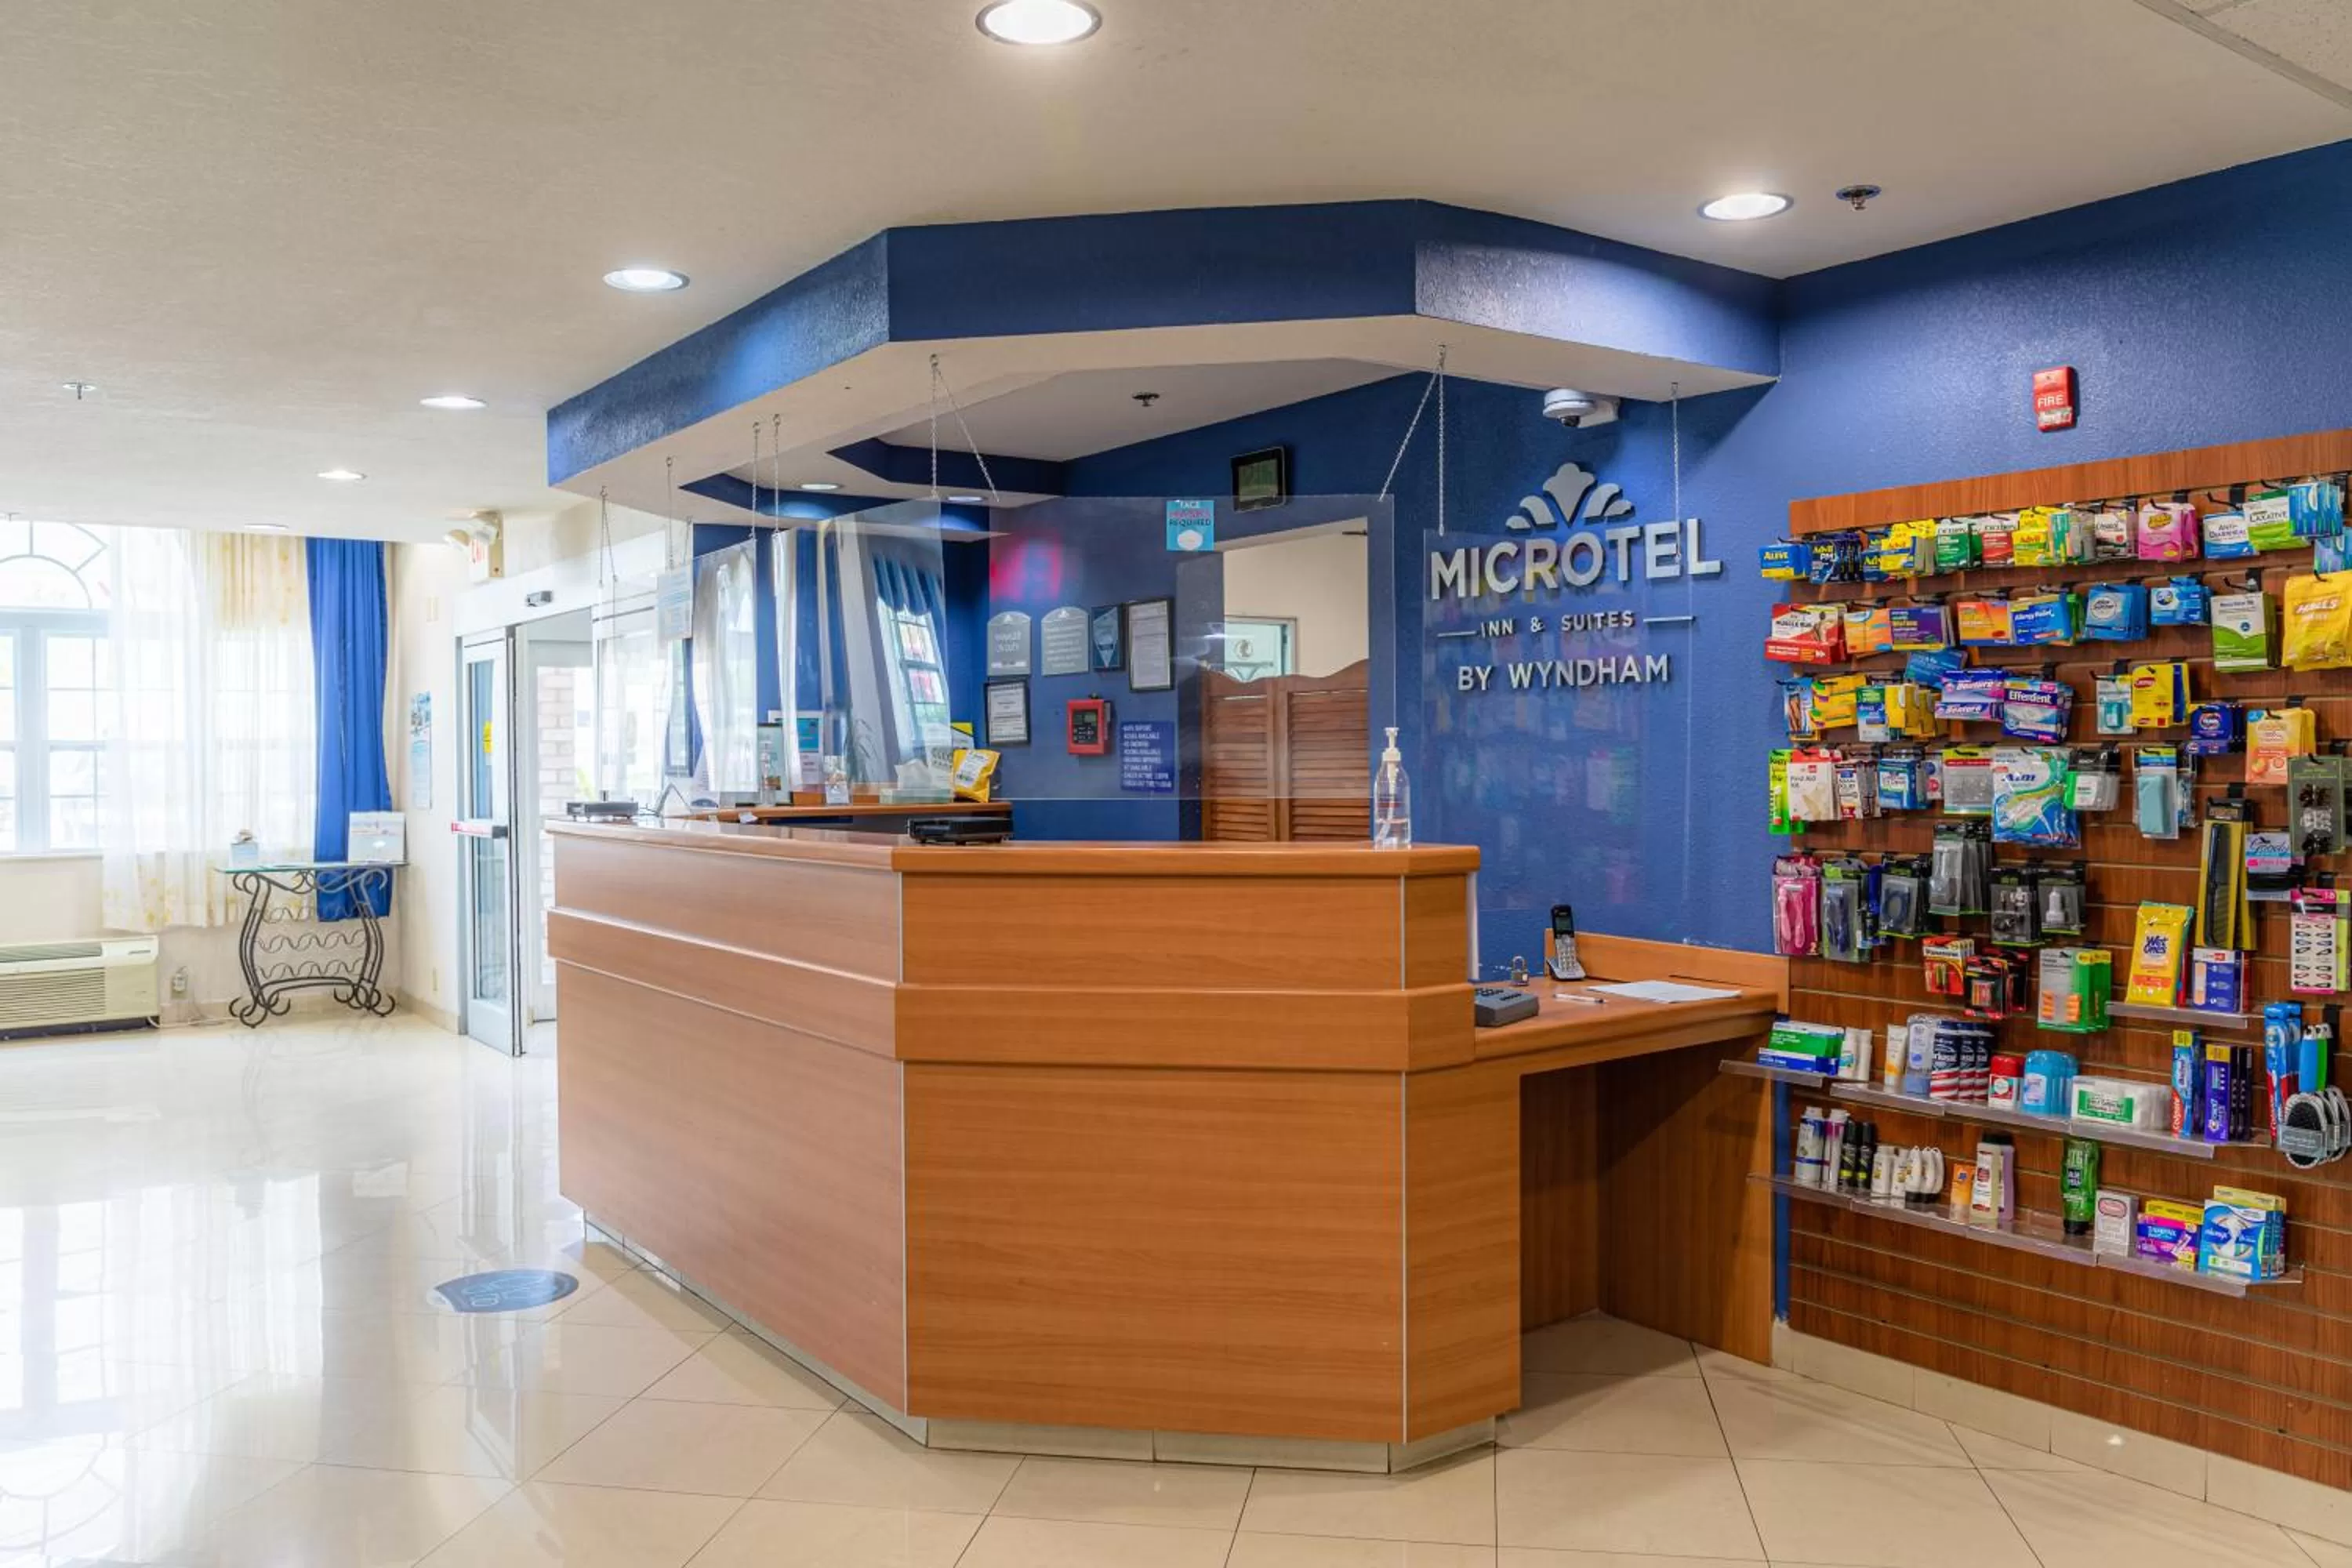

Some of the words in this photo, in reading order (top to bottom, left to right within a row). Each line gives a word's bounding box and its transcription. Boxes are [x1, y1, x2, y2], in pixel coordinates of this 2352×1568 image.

[2038, 394, 2064, 408] FIRE
[1430, 518, 1722, 601] MICROTEL
[1763, 551, 1788, 561] ALEVE
[2296, 598, 2340, 614] HALLS
[1480, 619, 1514, 640] INN
[1530, 616, 1544, 633] &
[1561, 610, 1635, 633] SUITES
[1457, 665, 1493, 691] BY
[1508, 653, 1669, 691] WYNDHAM
[2009, 691, 2052, 703] Efferdent
[2172, 1100, 2181, 1131] Colgate
